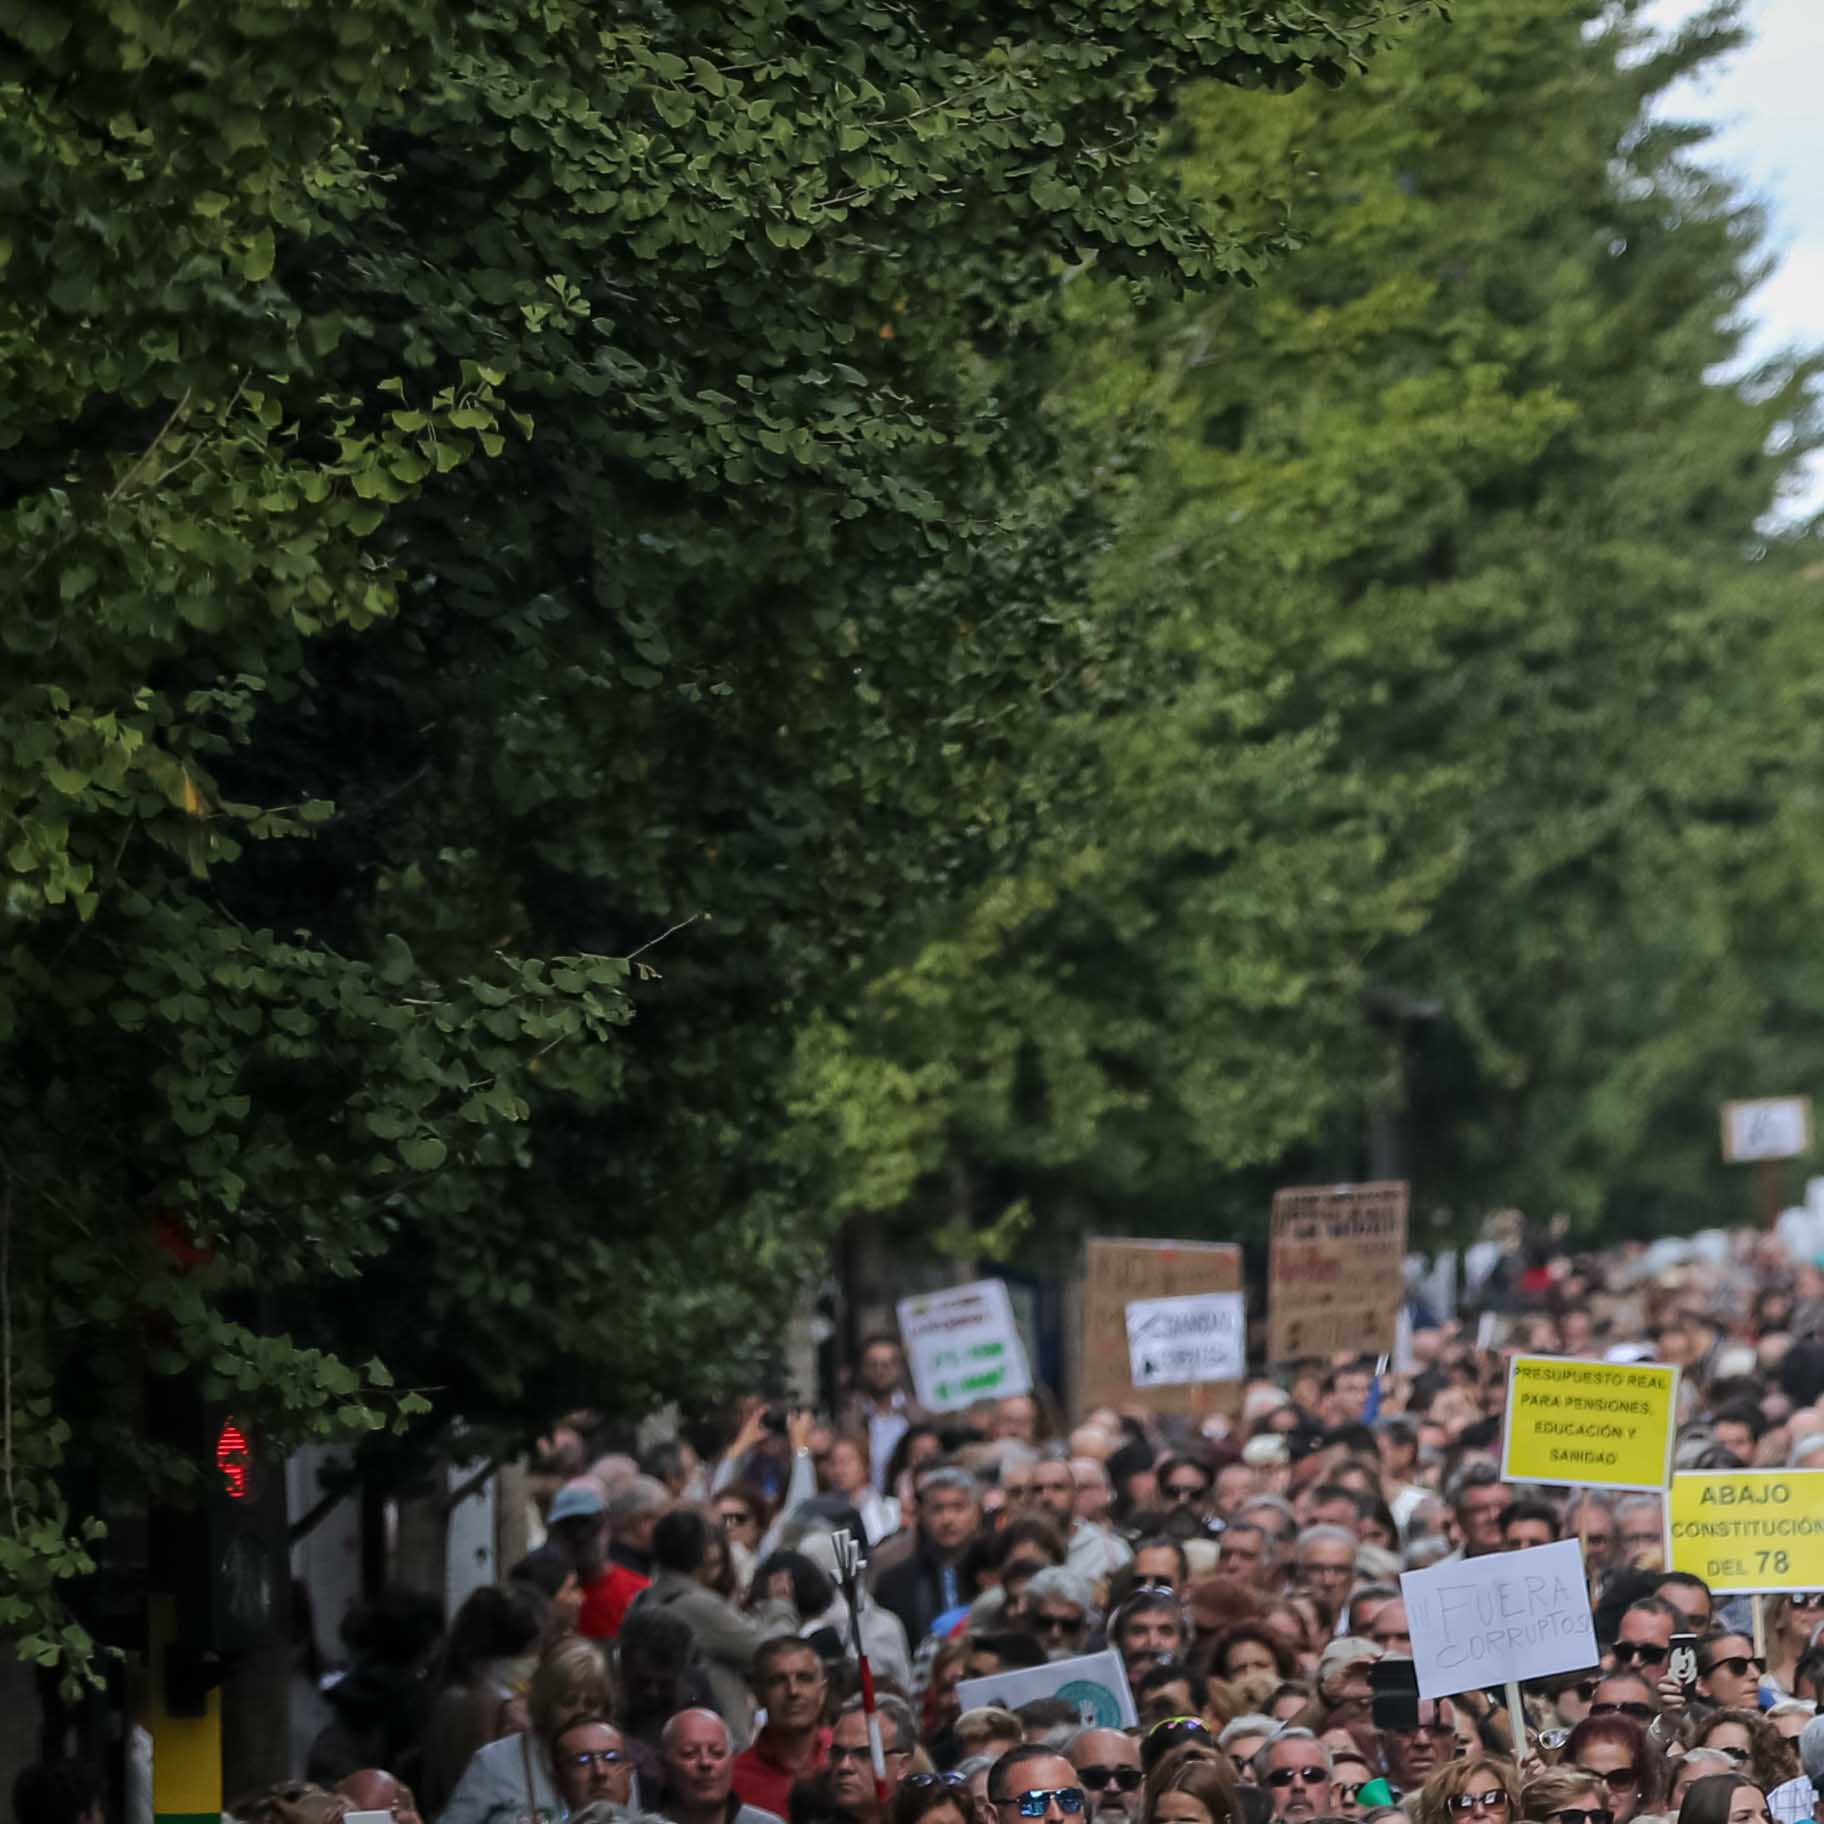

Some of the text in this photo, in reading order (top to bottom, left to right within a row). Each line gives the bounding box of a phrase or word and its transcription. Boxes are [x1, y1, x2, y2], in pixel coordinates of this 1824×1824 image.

[1514, 1367, 1667, 1389] PRESUPUESTO REAL
[1520, 1395, 1560, 1409] PARA
[1534, 1420, 1638, 1439] EDUCACIÓN Y
[1550, 1449, 1617, 1465] SANIDAD
[1700, 1484, 1791, 1505] ABAJO
[1706, 1551, 1790, 1577] DEL 78
